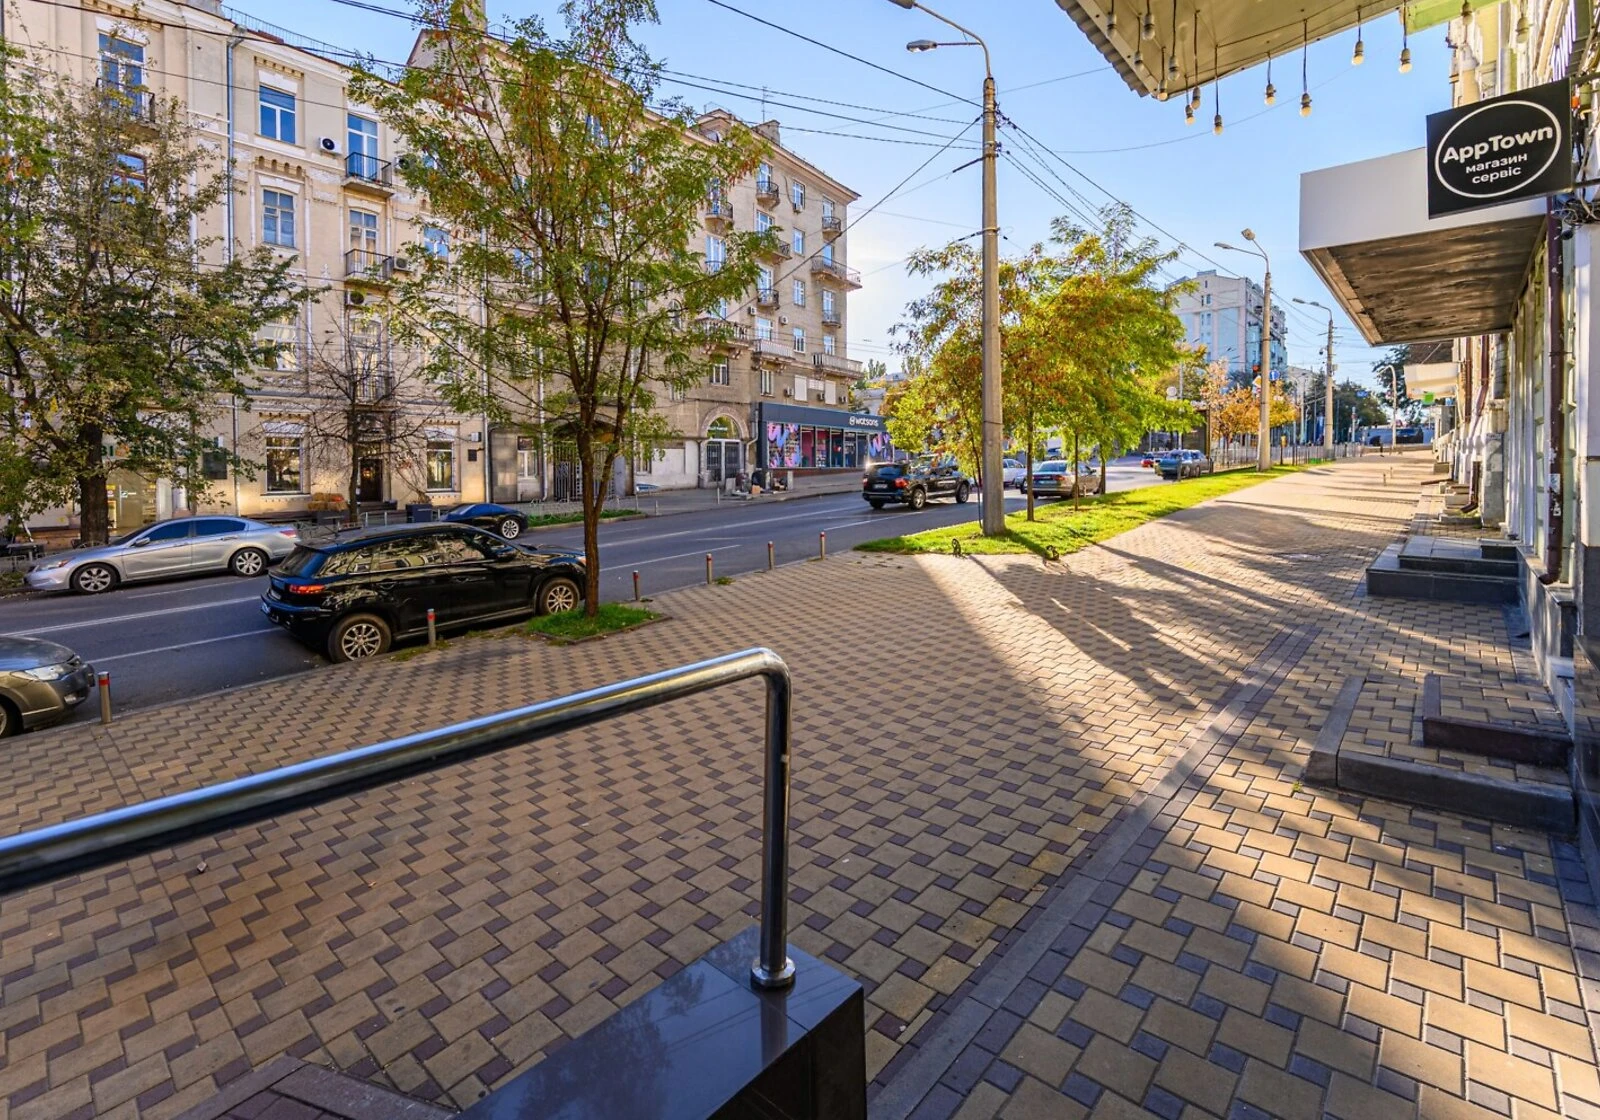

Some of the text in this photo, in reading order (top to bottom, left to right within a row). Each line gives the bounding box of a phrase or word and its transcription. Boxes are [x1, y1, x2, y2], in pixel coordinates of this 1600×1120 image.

[1442, 126, 1553, 164] AppTown
[1465, 153, 1528, 174] магазин
[1472, 166, 1522, 184] сервіс
